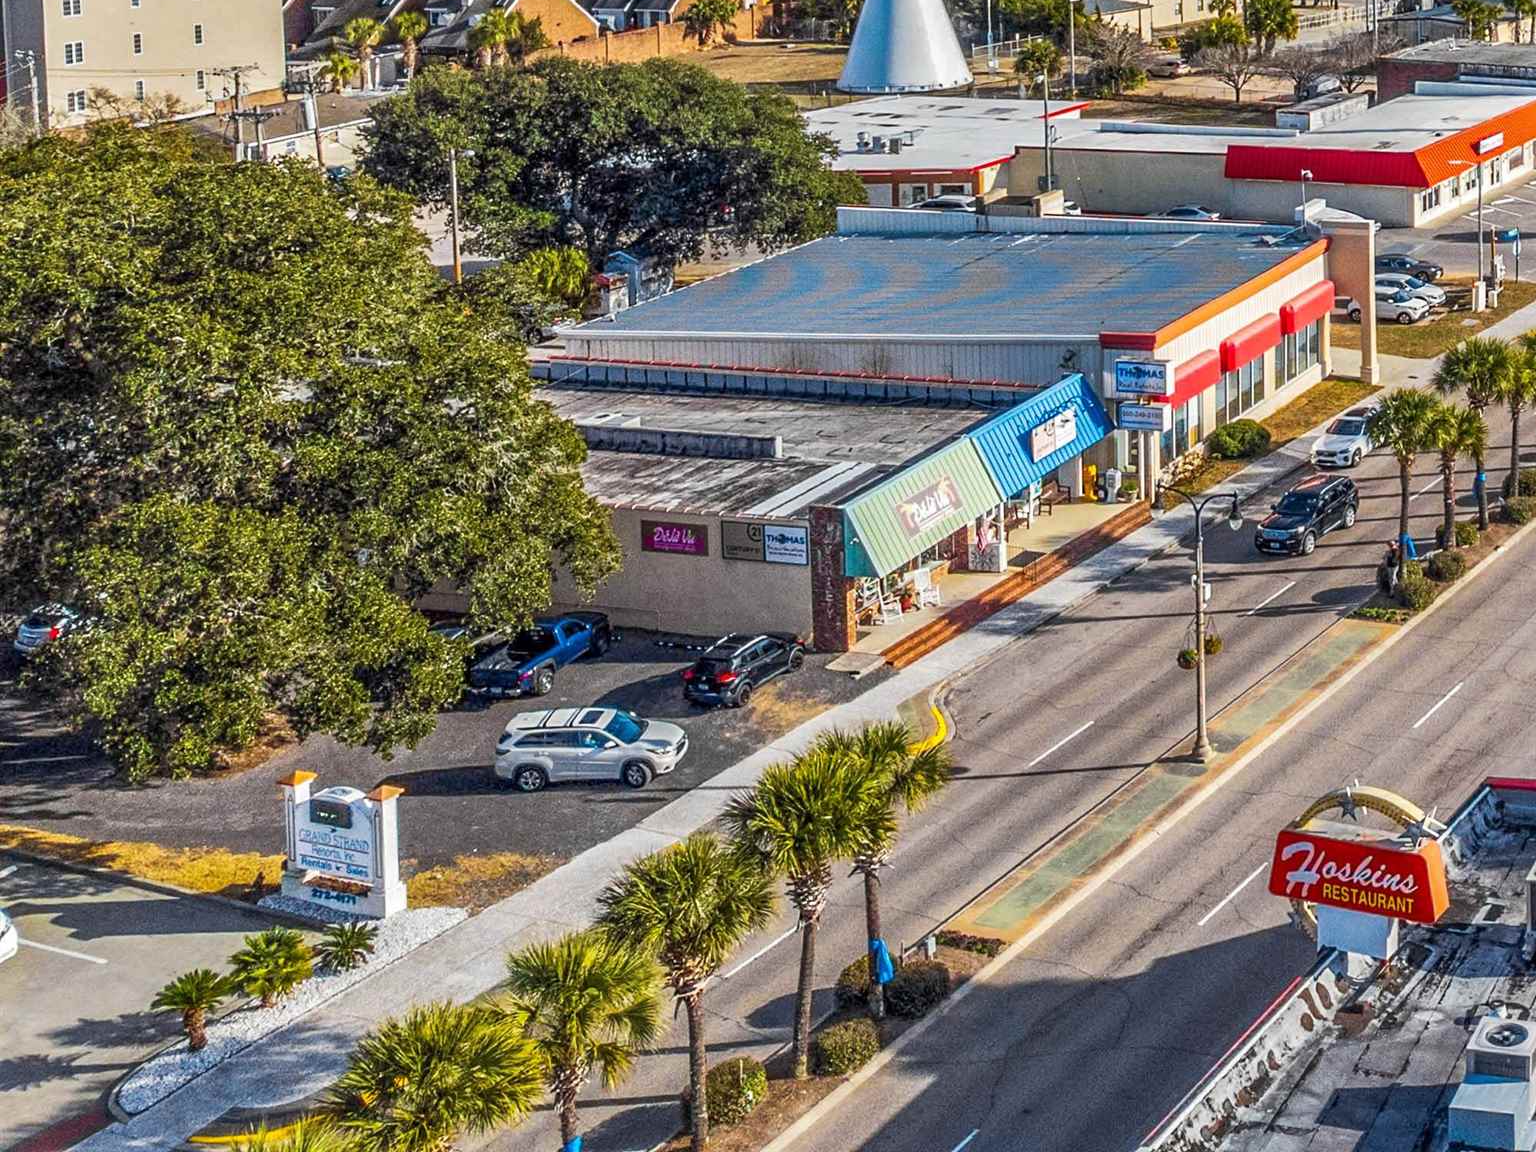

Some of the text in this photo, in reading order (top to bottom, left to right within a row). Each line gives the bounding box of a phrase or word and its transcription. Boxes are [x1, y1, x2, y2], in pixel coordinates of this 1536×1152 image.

[298, 828, 370, 850] GRAND STRAND
[300, 857, 369, 878] Rentals Sales
[1281, 841, 1419, 898] Hoskins
[1322, 883, 1414, 913] RESTAURANT
